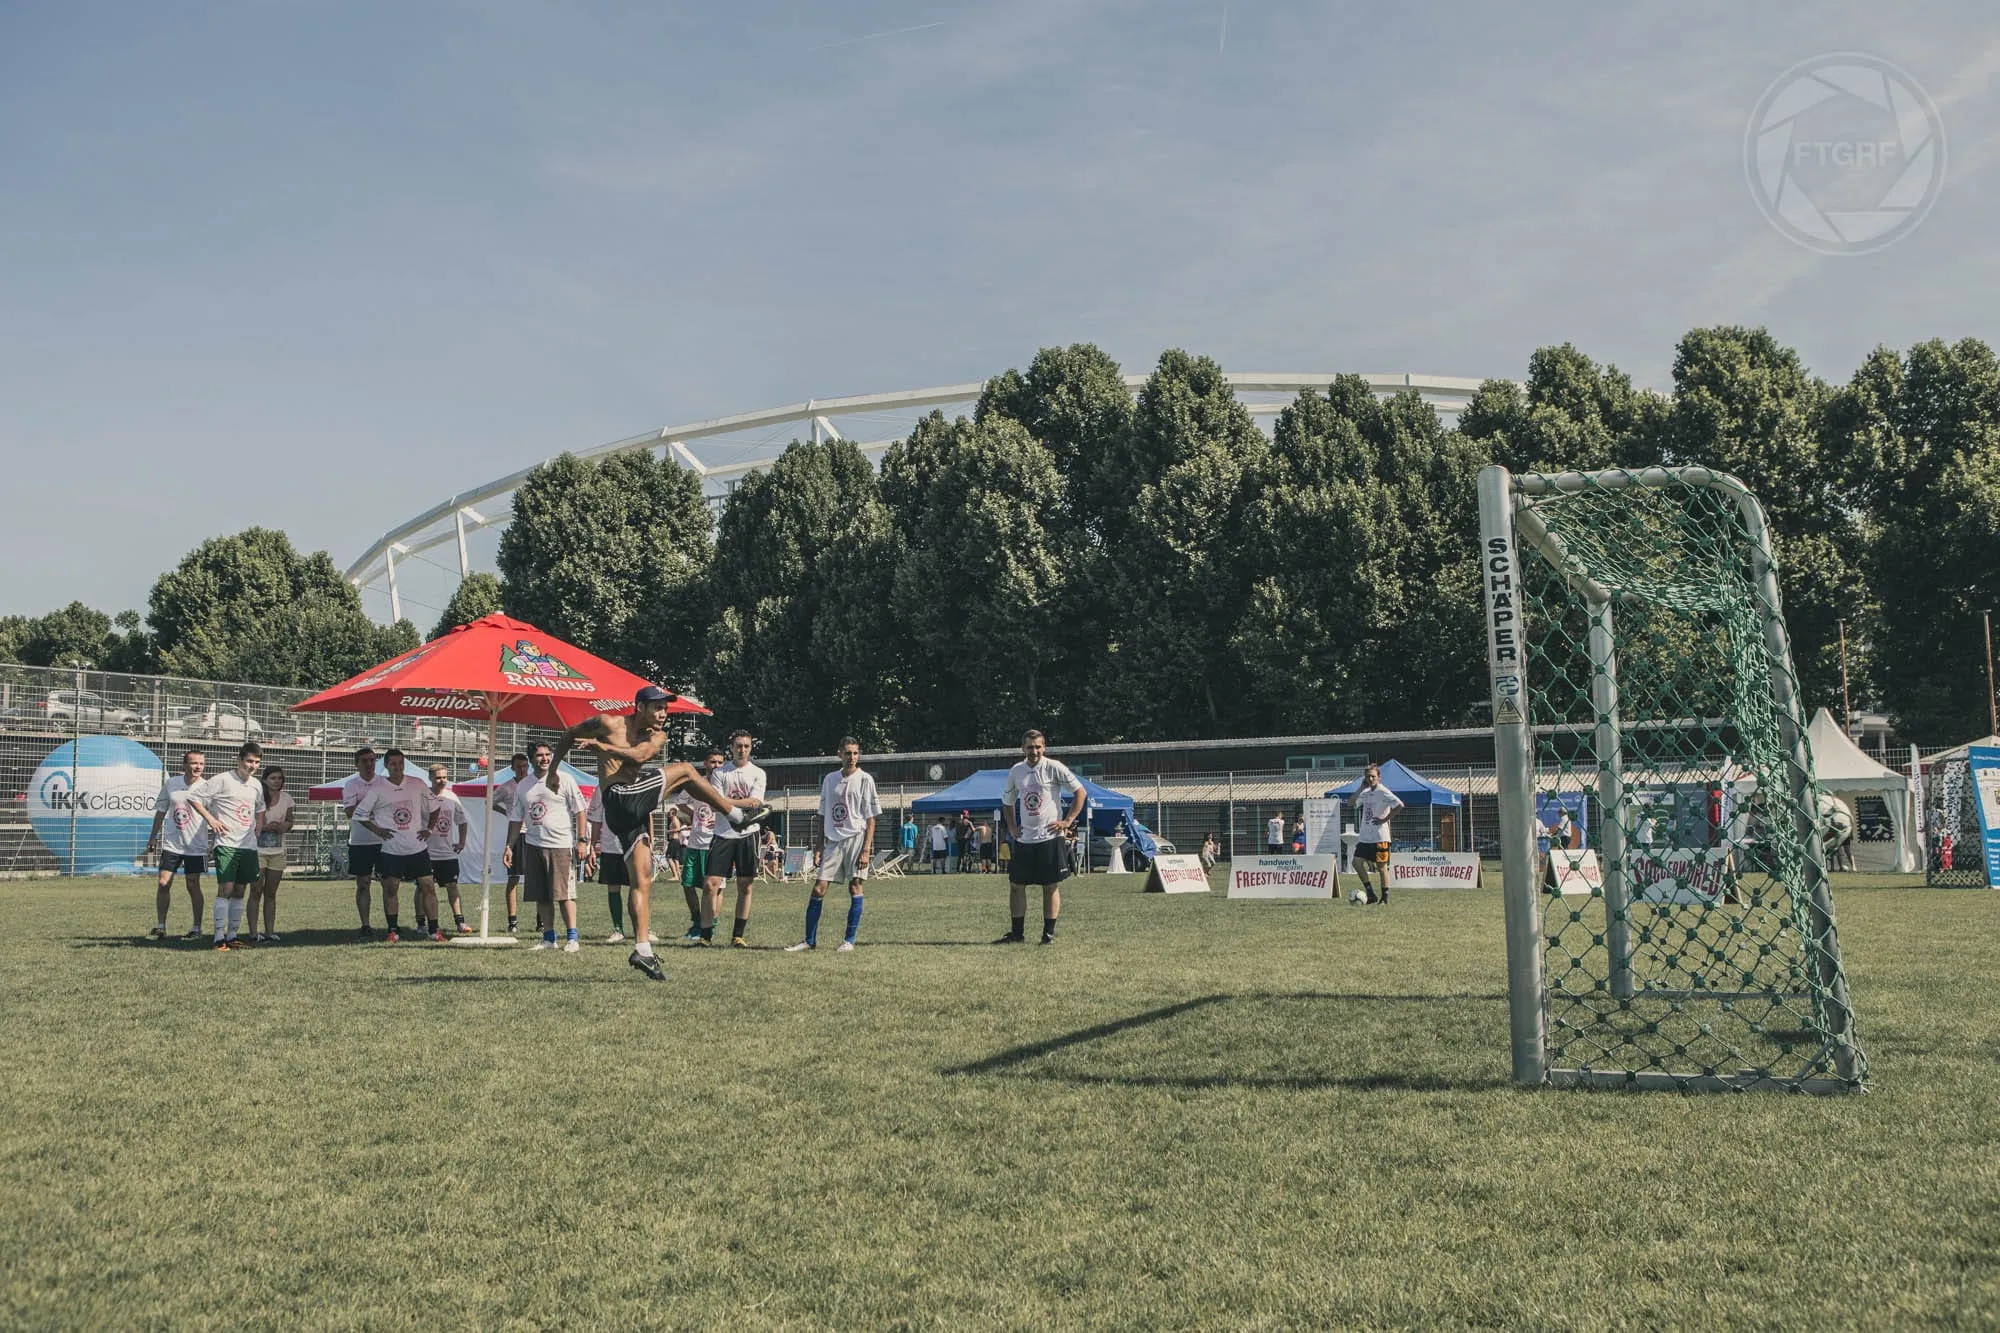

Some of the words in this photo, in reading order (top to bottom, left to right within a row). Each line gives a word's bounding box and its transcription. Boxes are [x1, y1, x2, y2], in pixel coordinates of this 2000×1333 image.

[1487, 537, 1516, 662] SCHÄPER
[503, 671, 597, 693] Rothaus
[89, 792, 156, 811] classic
[1258, 858, 1297, 867] handwerk
[1235, 869, 1288, 889] FREESTYLE
[1289, 869, 1329, 889] SOCCER
[1393, 865, 1438, 881] FREESTYLE
[1439, 865, 1473, 881] SOCCER
